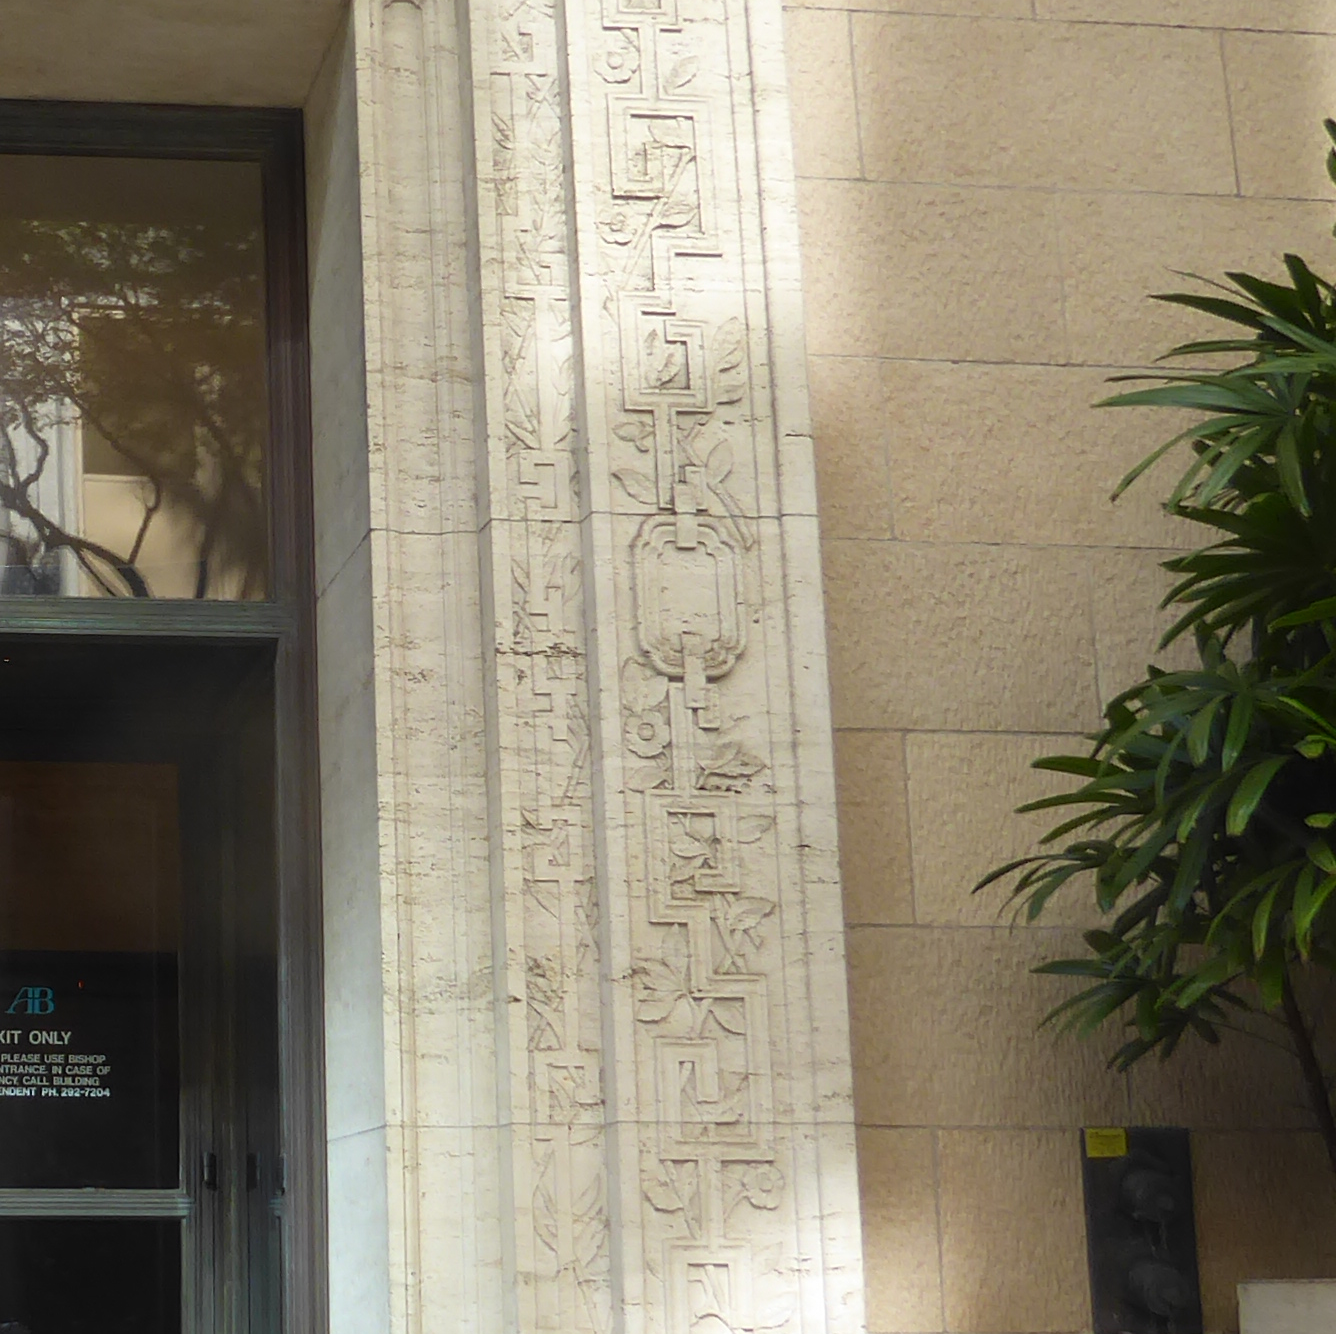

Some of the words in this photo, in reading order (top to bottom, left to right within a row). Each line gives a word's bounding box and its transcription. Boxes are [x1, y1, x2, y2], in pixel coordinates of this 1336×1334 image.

[29, 1031, 72, 1045] ONLY
[0, 1053, 41, 1063] PLEASE
[44, 1054, 65, 1063] USE
[68, 1054, 106, 1063] BISHOP
[51, 1066, 62, 1074] IN
[65, 1066, 93, 1074] CASE
[96, 1066, 111, 1075] OF
[22, 1076, 49, 1085] CALL
[53, 1076, 100, 1086] BUILDING
[41, 1087, 59, 1097] PH.
